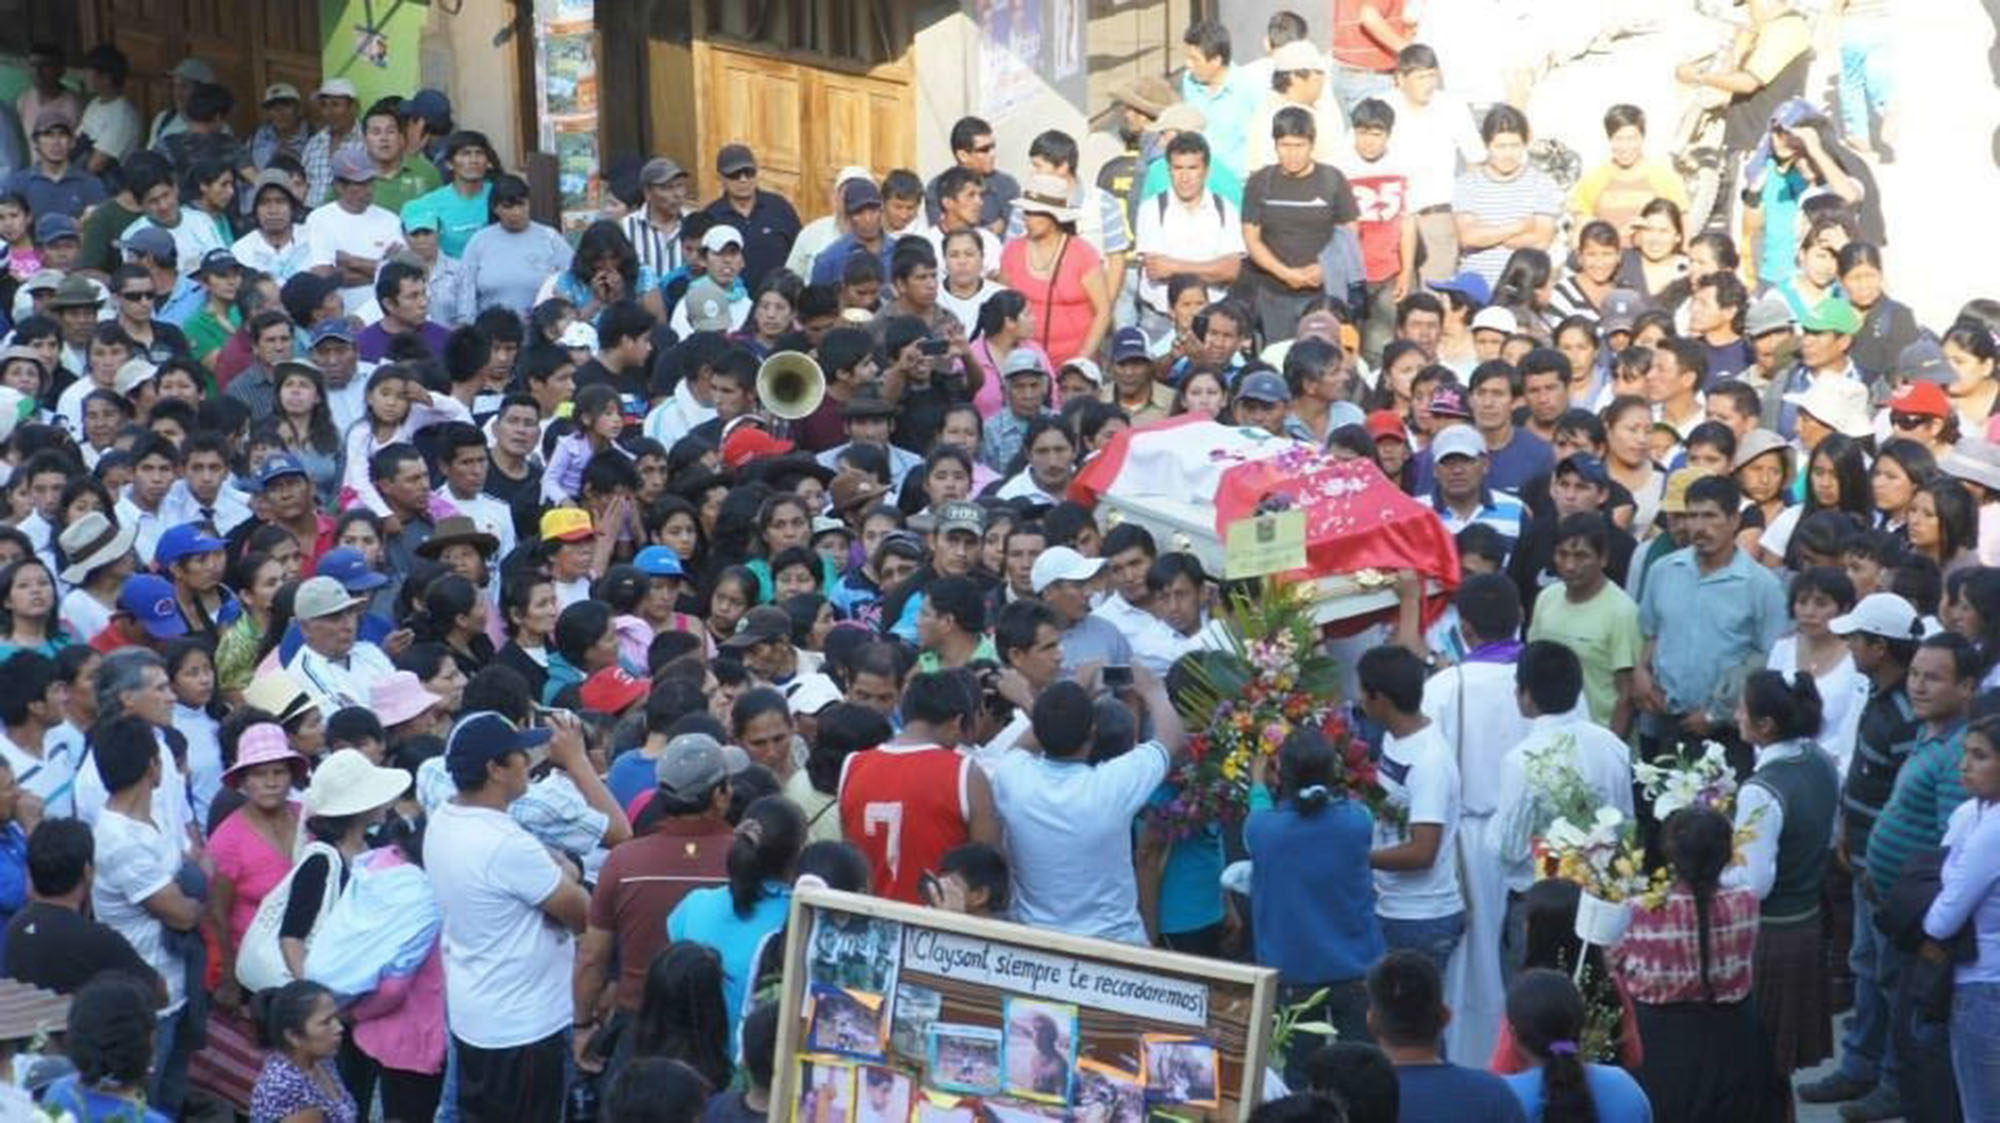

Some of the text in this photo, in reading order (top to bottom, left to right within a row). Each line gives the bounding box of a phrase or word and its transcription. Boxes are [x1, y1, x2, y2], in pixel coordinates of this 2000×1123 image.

[864, 801, 903, 882] 7
[994, 953, 1061, 990] siempre
[1069, 962, 1089, 989] te
